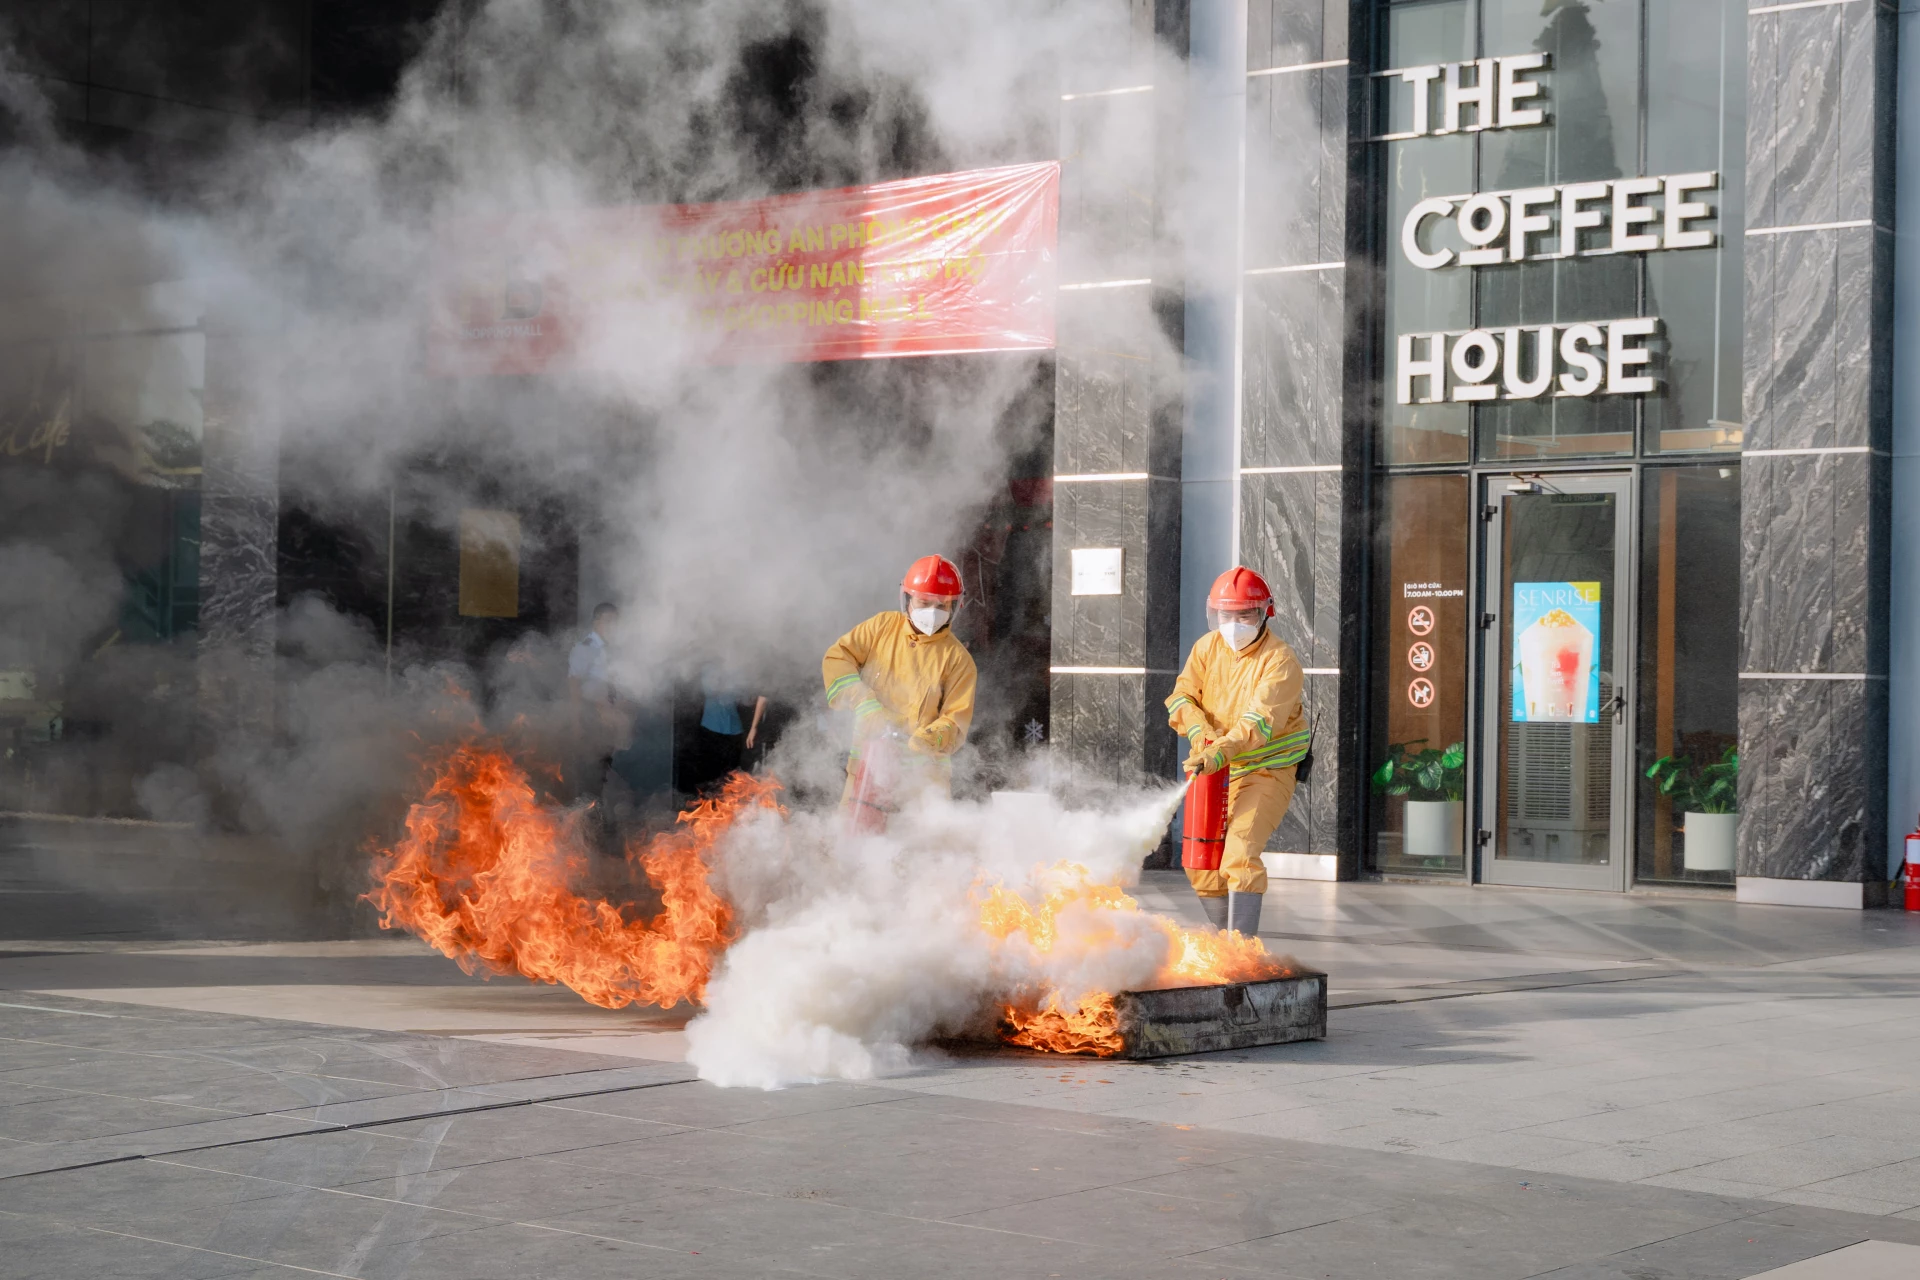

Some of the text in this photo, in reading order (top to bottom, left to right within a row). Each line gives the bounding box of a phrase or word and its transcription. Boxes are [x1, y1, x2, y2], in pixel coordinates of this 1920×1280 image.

[1402, 52, 1551, 136] THE
[676, 228, 783, 262] PHƯƠNG
[788, 220, 825, 254] ÁN
[1401, 171, 1721, 270] COFFEE
[748, 255, 805, 293] CỨU
[722, 297, 854, 332] SHOPPING
[1397, 317, 1661, 405] HOUSE
[1518, 588, 1595, 606] SENRISE
